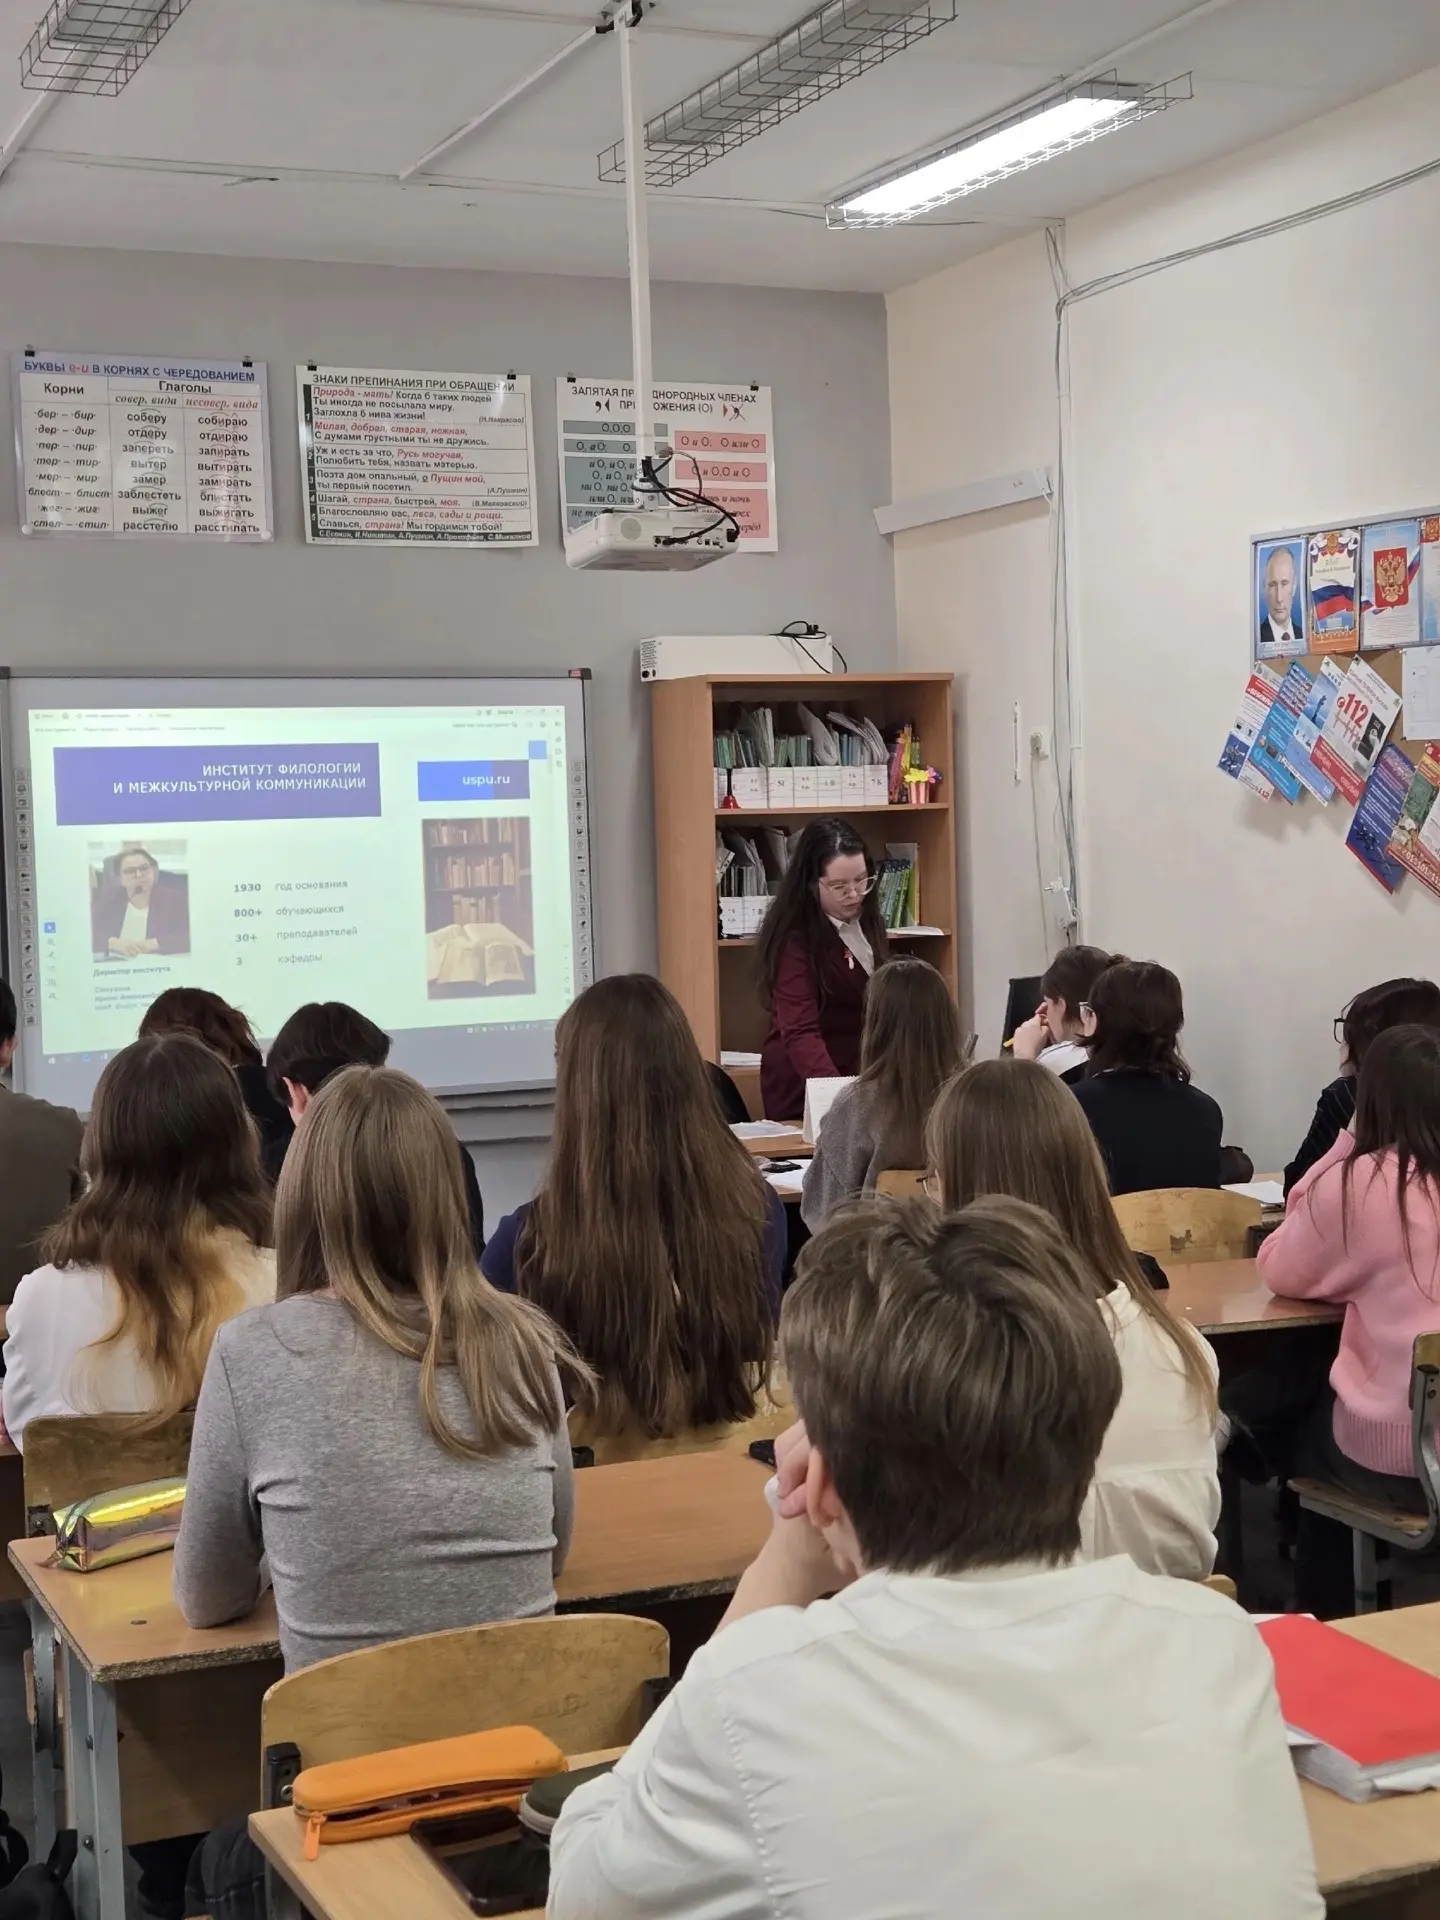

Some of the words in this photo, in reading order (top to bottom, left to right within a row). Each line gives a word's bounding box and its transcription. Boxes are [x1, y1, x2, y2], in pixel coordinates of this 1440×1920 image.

[24, 361, 65, 372] БУКВЫ
[92, 364, 100, 374] В
[104, 365, 149, 376] КОРНЯХ
[153, 368, 160, 376] С
[164, 368, 255, 381] ЧЕРЕДОВАНИЕМ
[159, 380, 212, 394] Глаголы
[313, 374, 347, 384] ЗНАКИ
[351, 376, 422, 387] ПРЕПИНАНИЯ
[426, 380, 446, 388] ПРИ
[44, 383, 84, 396] Корни
[313, 387, 355, 398] Природа
[396, 391, 424, 400] Когда
[434, 393, 458, 401] таких
[461, 394, 492, 404] людей
[572, 386, 619, 396] ЗАПЯТАЯ
[652, 390, 716, 401] ДНОРОДНЫХ
[718, 393, 756, 403] ЧЛЕНАХ
[152, 396, 177, 405] вида
[314, 396, 328, 404] Ты
[331, 399, 362, 407] иногда
[379, 402, 426, 410] посылала
[127, 412, 167, 424] соберу
[314, 408, 357, 417] Заглохла
[394, 412, 425, 420] жизни!
[128, 429, 167, 440] отдеру
[315, 431, 321, 439] С
[364, 435, 415, 443] грустными
[122, 444, 174, 454] запереть
[316, 446, 328, 454] Уж
[397, 449, 419, 459] Русь
[130, 460, 167, 470] вытер
[316, 456, 365, 466] Полюбить
[394, 460, 431, 468] назвать
[133, 476, 166, 486] замер
[317, 470, 344, 479] Поэта
[431, 474, 463, 484] Пущин
[333, 481, 369, 491] первый
[118, 490, 181, 500] заблестеть
[132, 506, 168, 515] выжег
[319, 507, 388, 517] Благословляю
[440, 510, 464, 519] сады
[123, 522, 178, 534] расстелю
[1343, 693, 1369, 729] 112
[203, 764, 273, 776] ИНСТИТУТ
[278, 762, 361, 775] ФИЛОЛОГИИ
[114, 782, 122, 794] И
[129, 778, 250, 793] МЕЖКУЛЬТУРНОЙ
[256, 777, 366, 791] КОММУНИКАЦИИ
[463, 775, 510, 787] uspu.ru
[234, 883, 261, 893] 1930
[275, 882, 292, 891] год
[295, 881, 348, 890] основания
[234, 908, 262, 918] 800+
[276, 906, 344, 916] обучающихся
[235, 933, 257, 943] 30+
[277, 926, 358, 940] преподавателей
[236, 957, 243, 966] 3
[277, 954, 323, 965] кафедры
